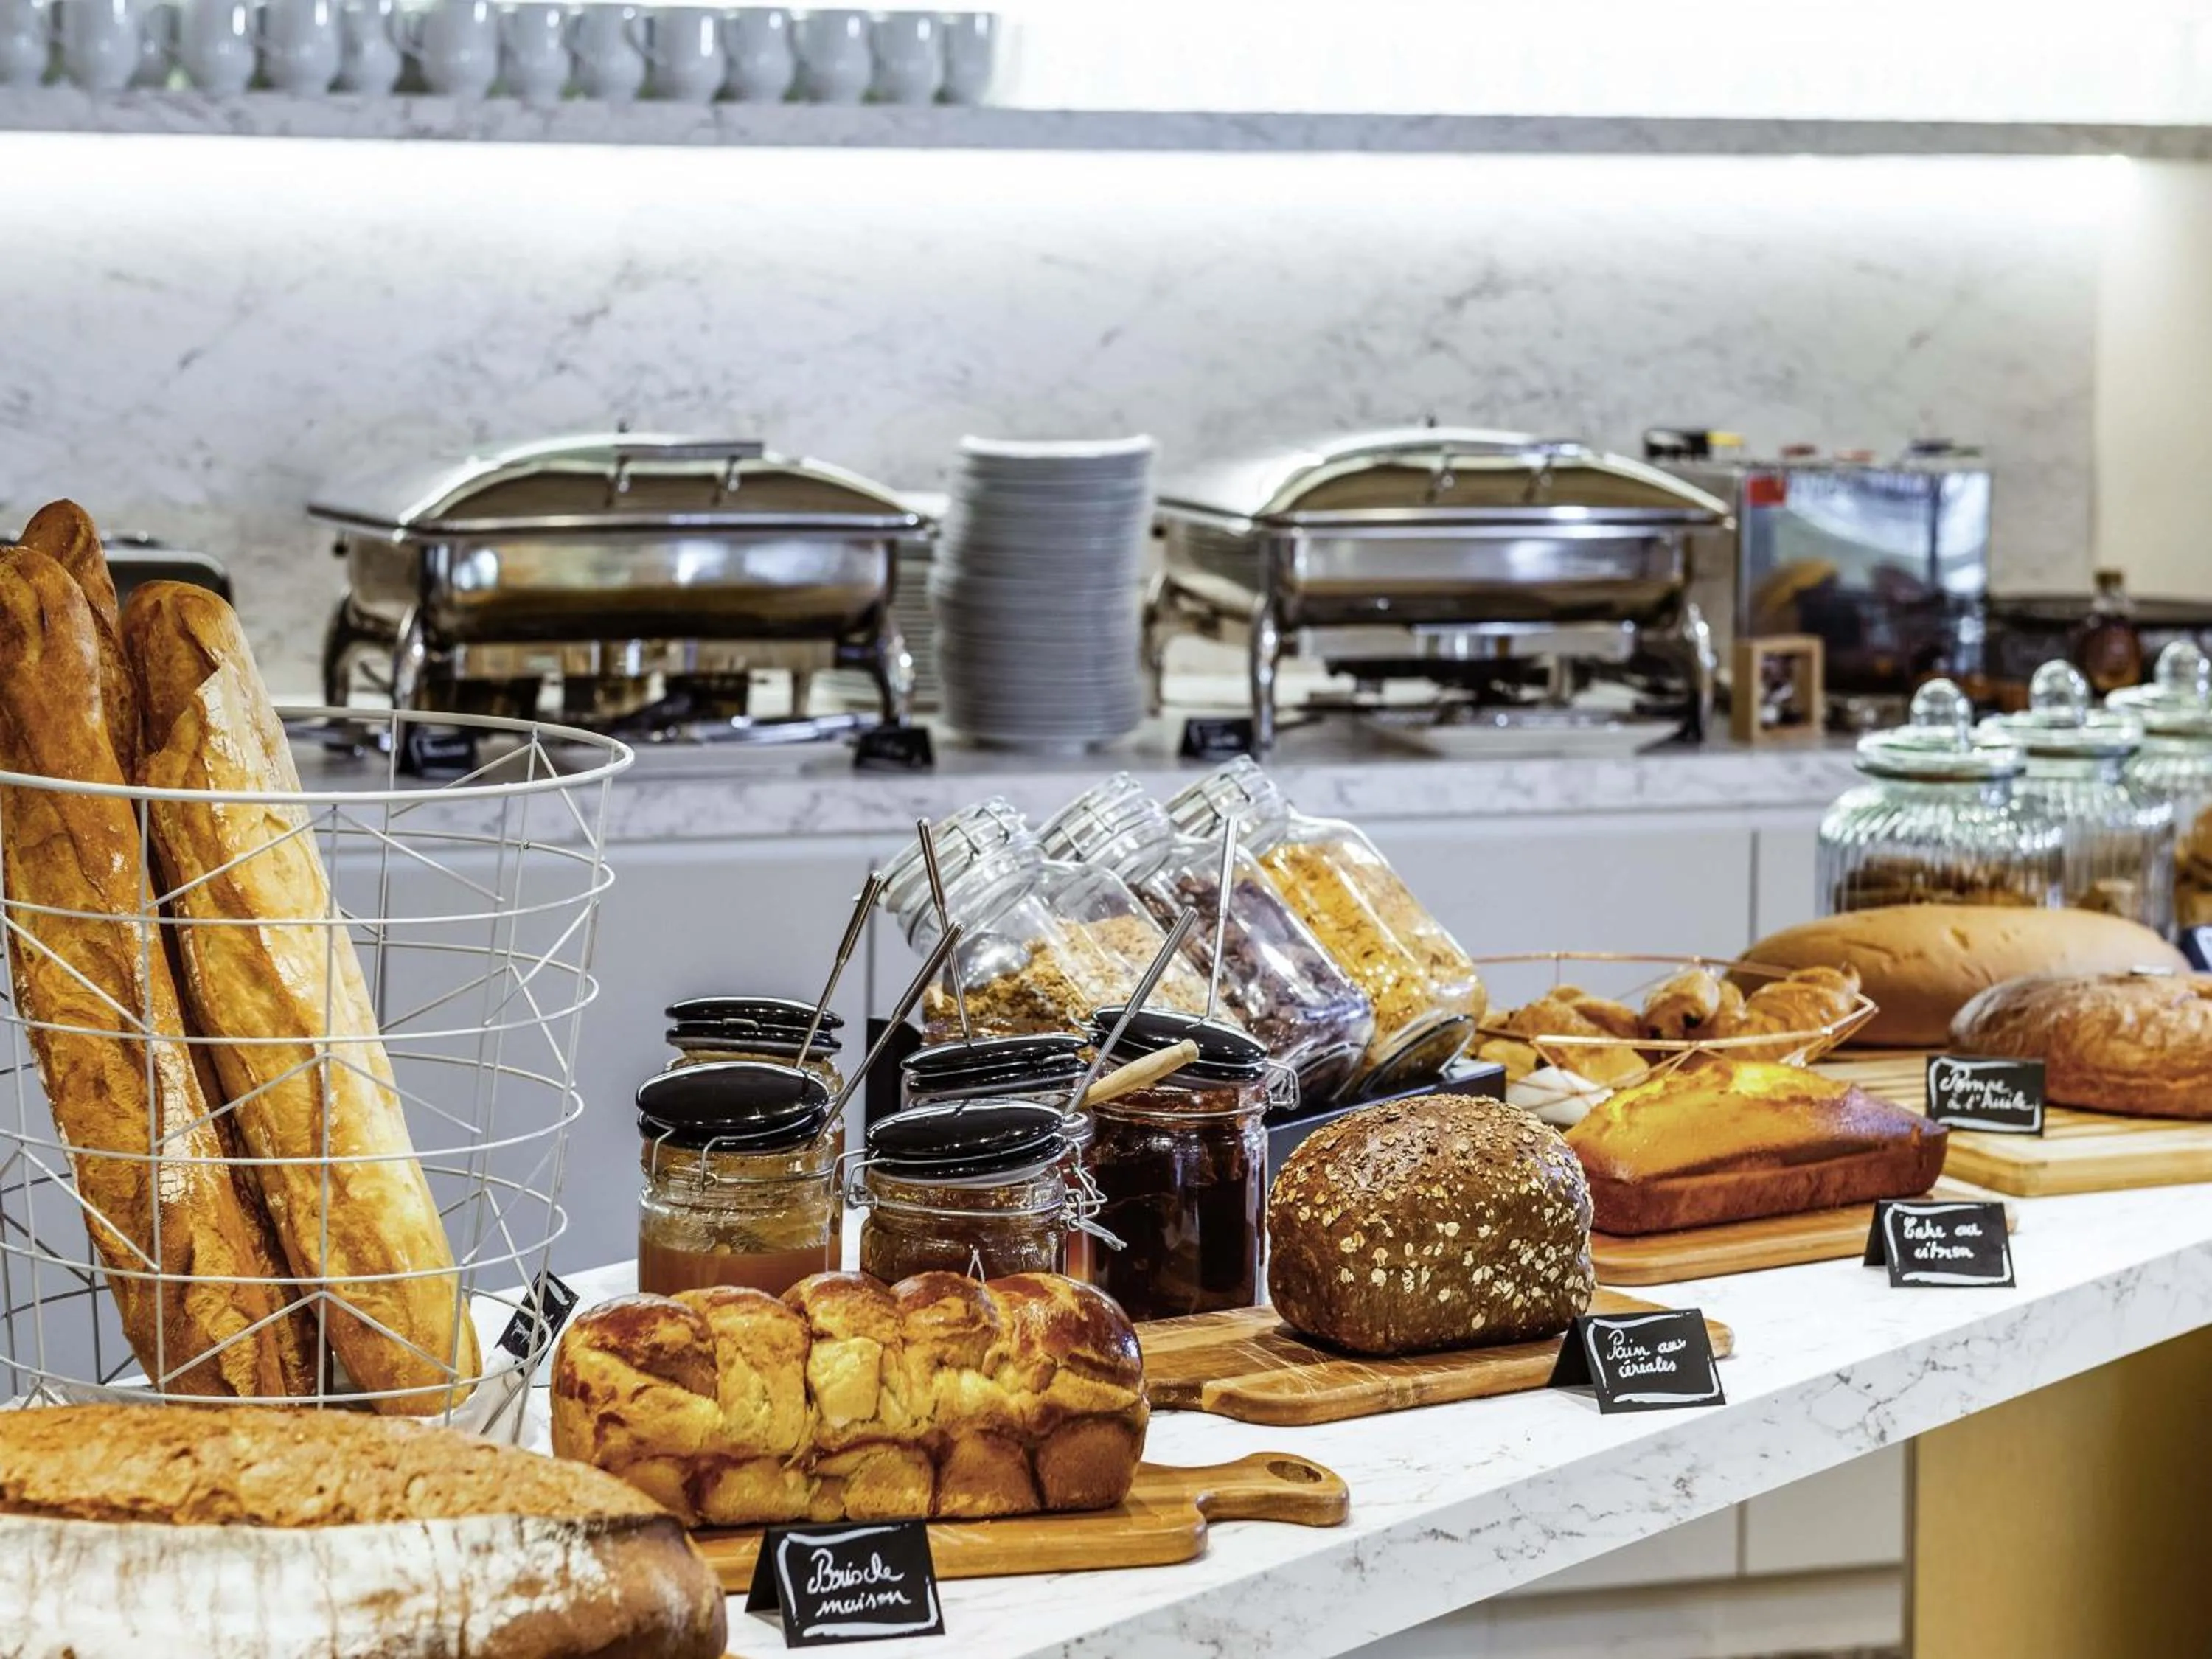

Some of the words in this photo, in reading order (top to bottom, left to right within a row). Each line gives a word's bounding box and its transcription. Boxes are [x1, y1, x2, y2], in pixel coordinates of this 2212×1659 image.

[1954, 1222, 1983, 1237] au
[1913, 1240, 1975, 1259] citron
[1607, 1329, 1651, 1361] Pain
[1657, 1338, 1687, 1354] aux
[1618, 1355, 1677, 1379] céréales
[815, 1591, 913, 1618] maison
